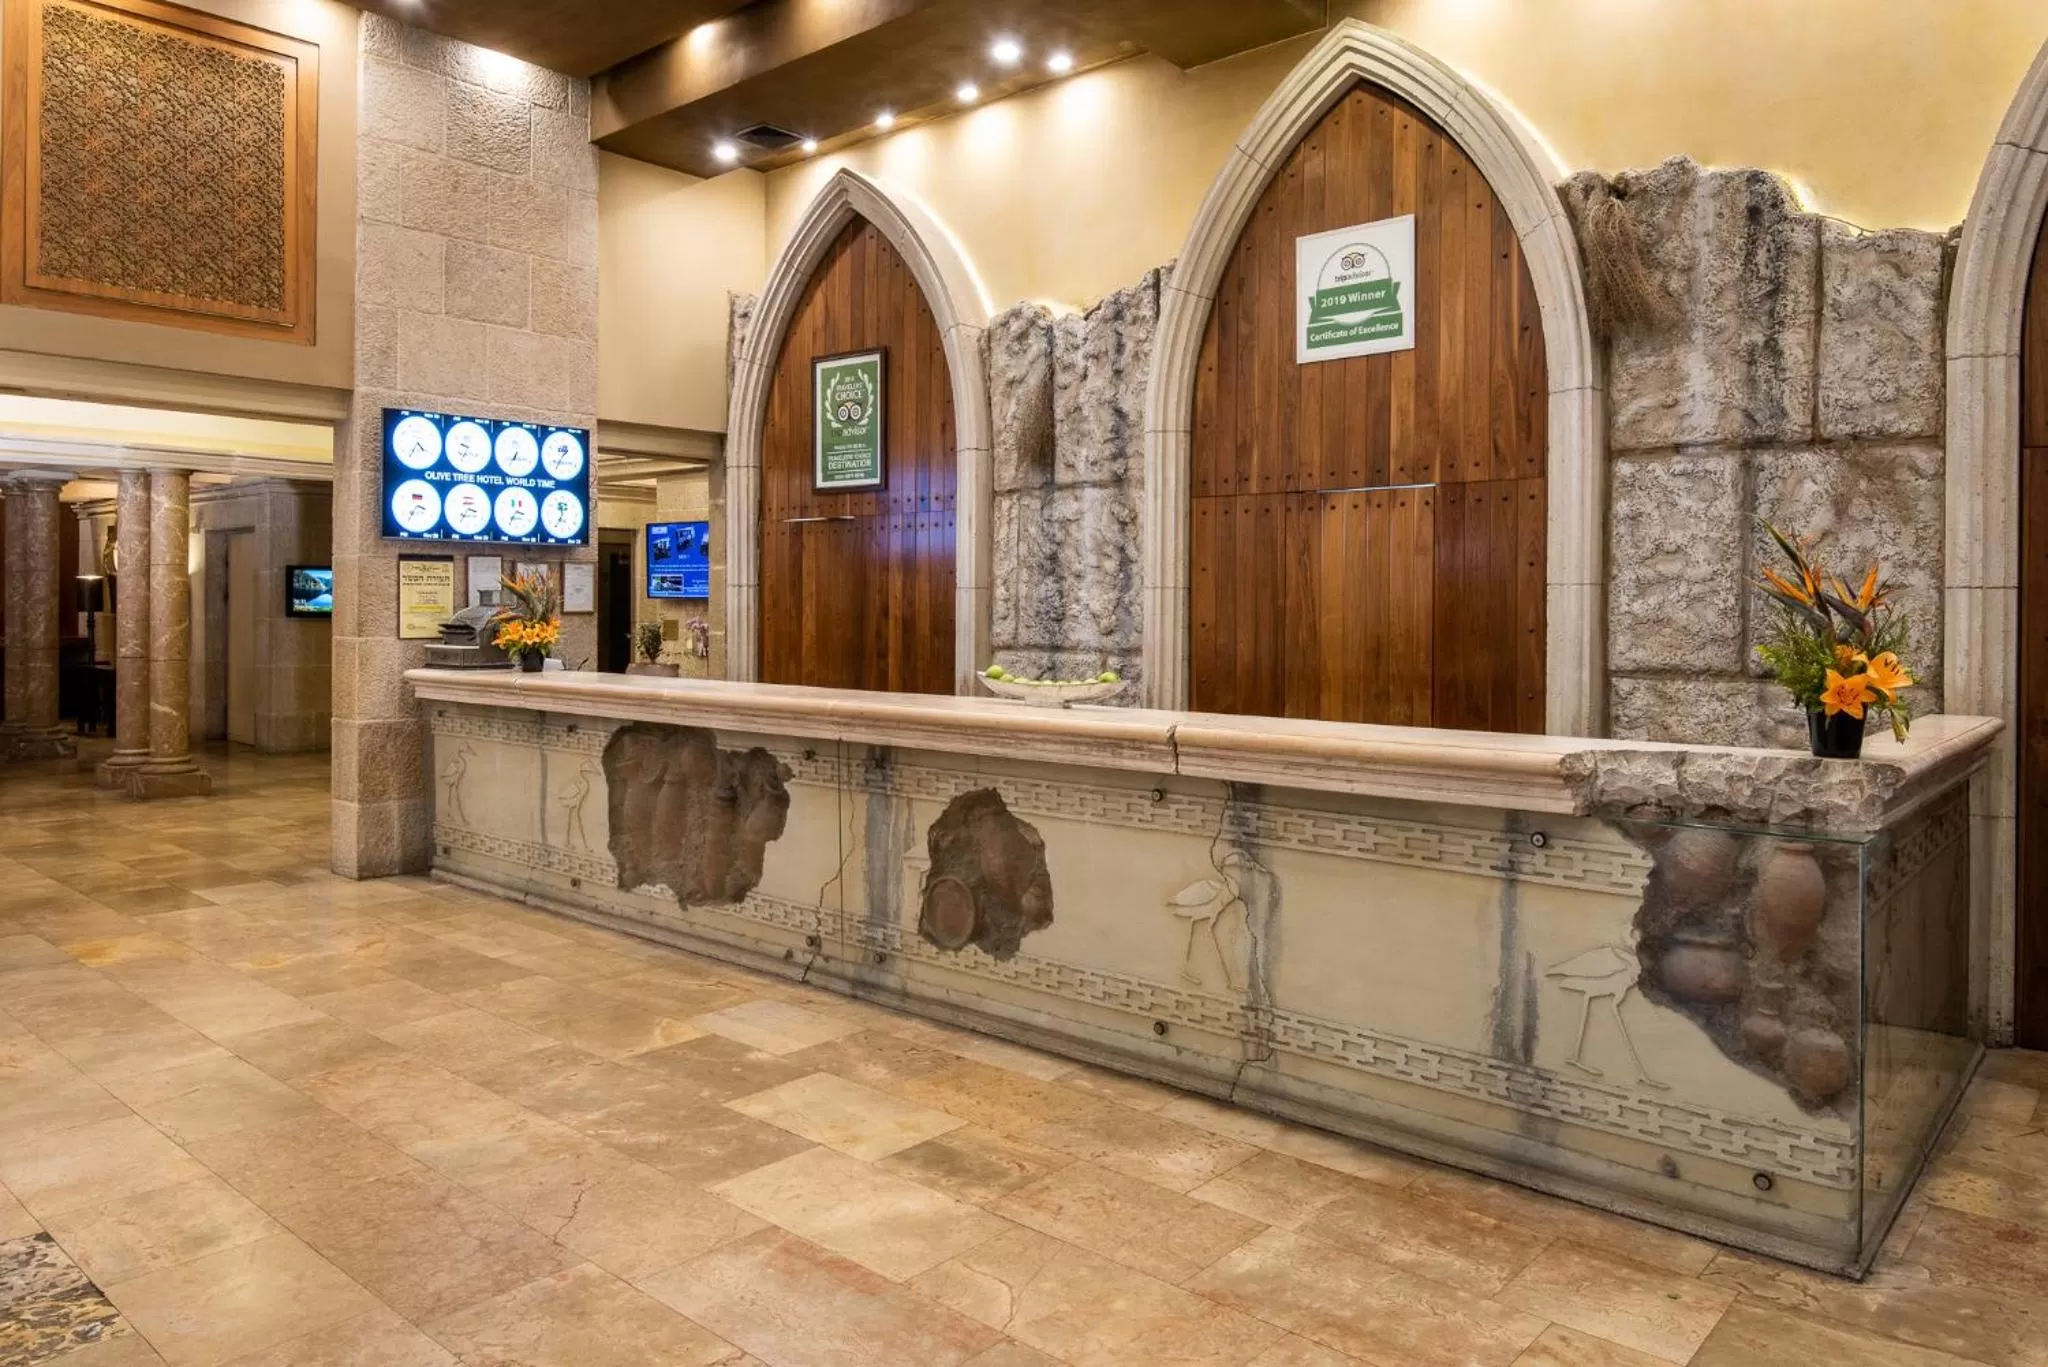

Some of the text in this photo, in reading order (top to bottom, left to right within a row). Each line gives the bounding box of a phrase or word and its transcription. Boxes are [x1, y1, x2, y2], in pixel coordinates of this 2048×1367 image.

[1320, 289, 1386, 308] 2019 Winner
[1310, 322, 1399, 342] Certificate of Excellence
[835, 389, 862, 401] CHOICE
[828, 458, 872, 470] DESTINATION
[425, 471, 556, 489] OLIVE TREE HOTEL WORLD TIME
